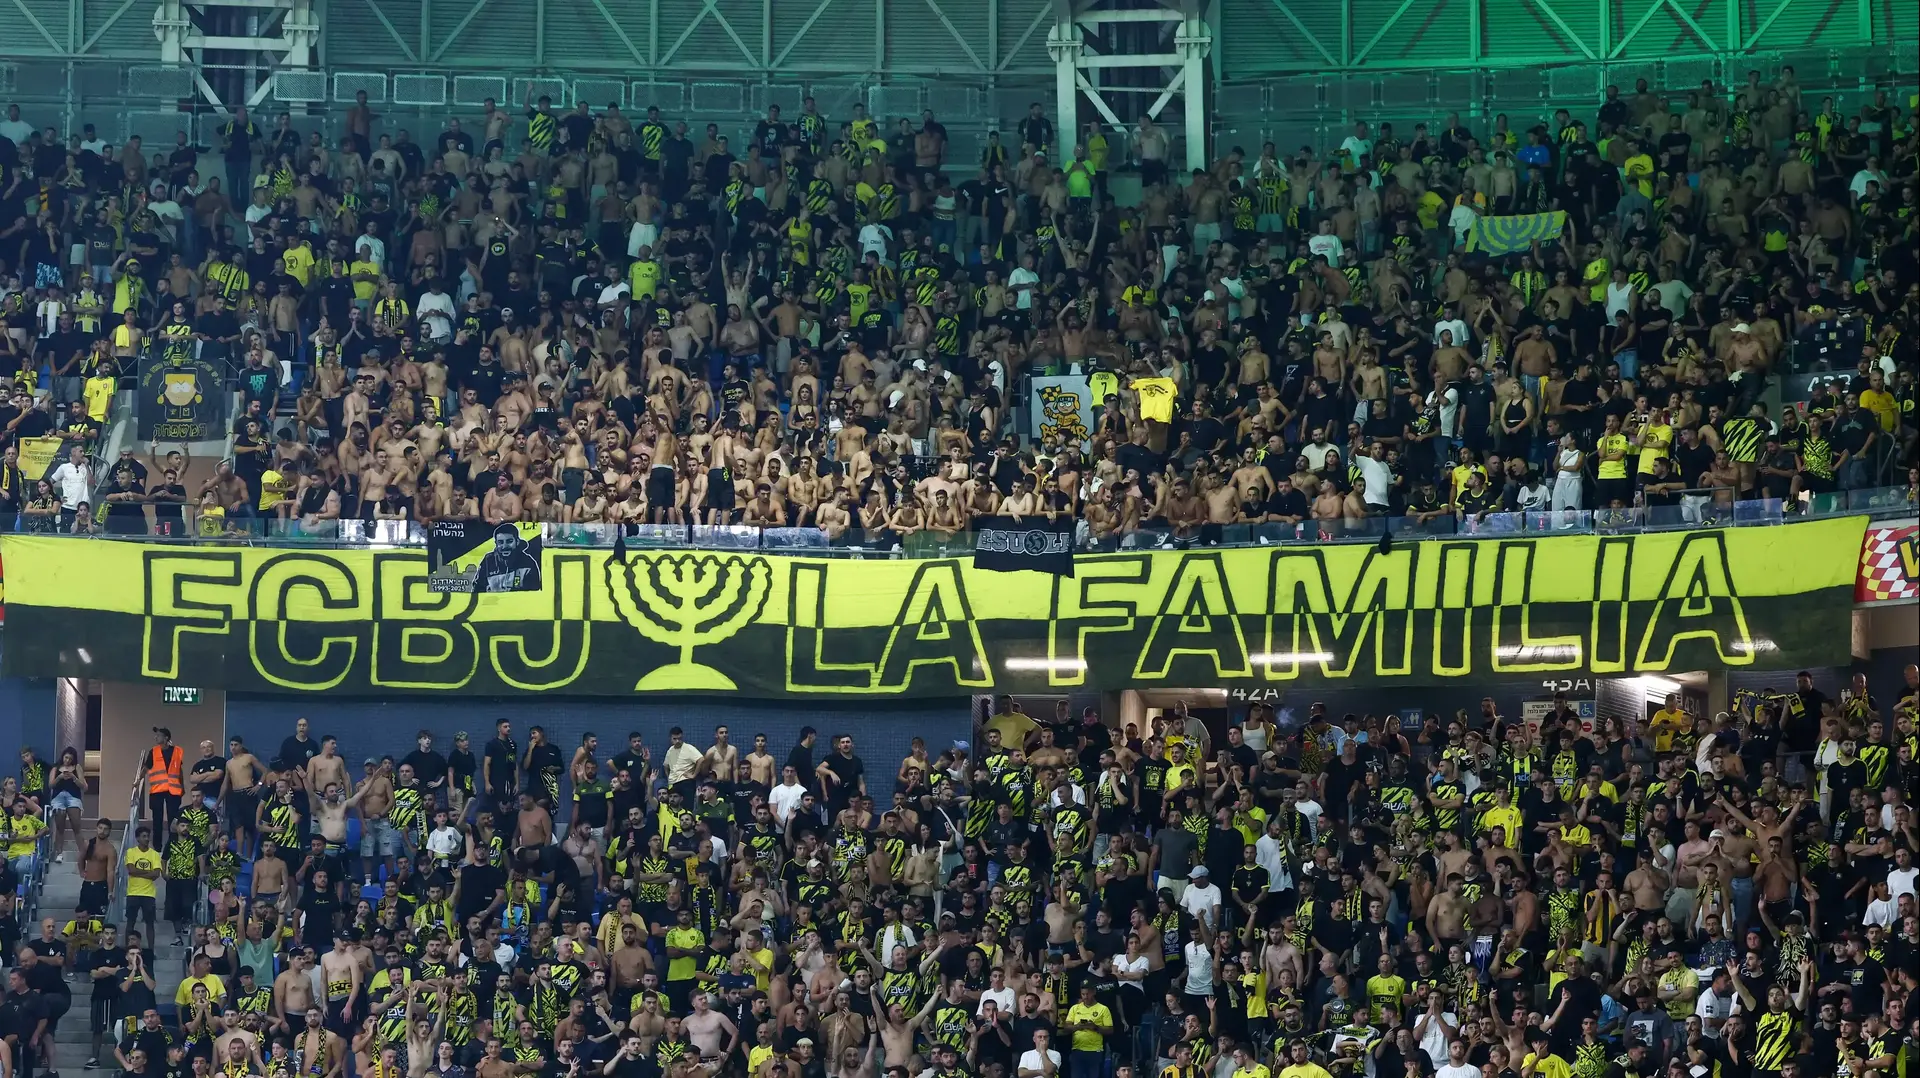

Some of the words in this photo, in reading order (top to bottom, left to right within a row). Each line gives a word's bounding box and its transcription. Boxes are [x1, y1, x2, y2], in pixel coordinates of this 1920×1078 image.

[1100, 381, 1107, 396] 7
[153, 423, 208, 438] המשפחה
[433, 529, 465, 538] מהשרון
[141, 550, 592, 691] FCBJ
[785, 559, 994, 695] LA
[1049, 529, 1756, 688] FAMILIA
[163, 687, 197, 702] יציאה
